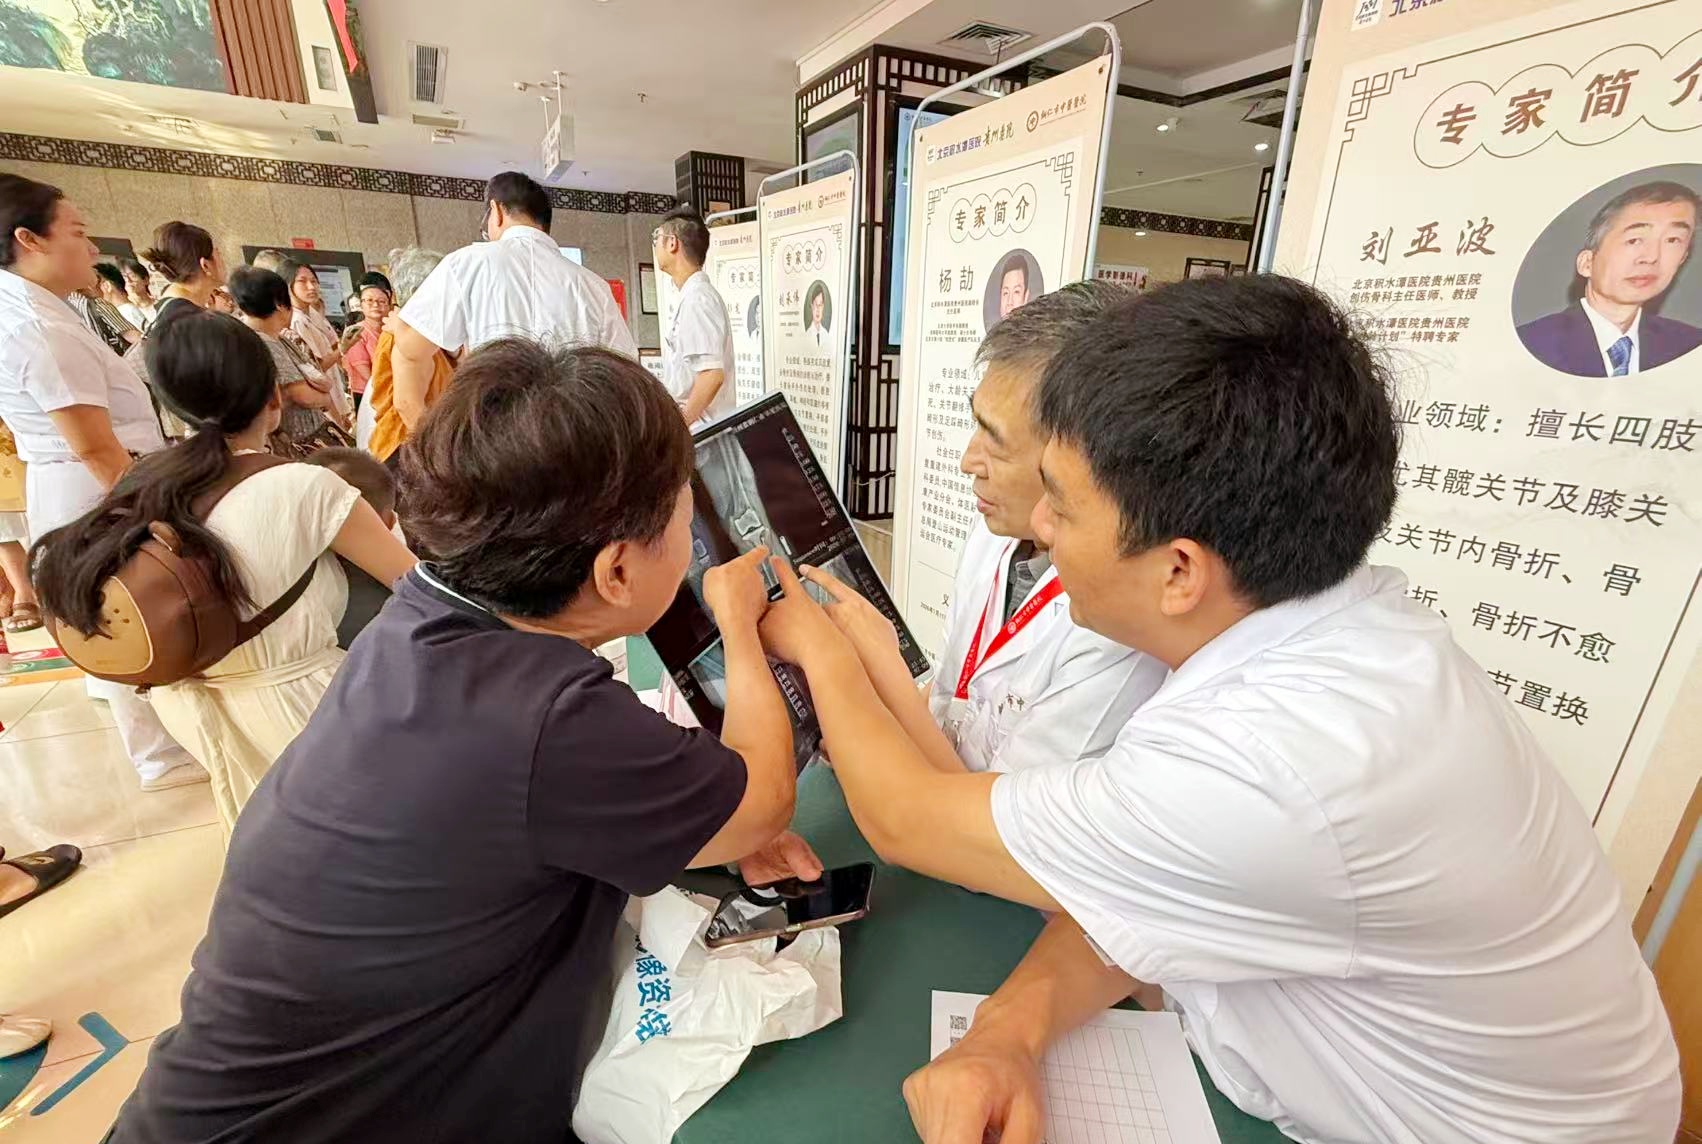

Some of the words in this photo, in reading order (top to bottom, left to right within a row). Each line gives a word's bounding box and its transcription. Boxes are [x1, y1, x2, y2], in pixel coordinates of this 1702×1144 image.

[955, 195, 1030, 231] 专家简介
[786, 247, 823, 266] 专家简介
[1360, 216, 1497, 266] 刘亚波
[1350, 288, 1479, 304] 创伤骨科主任医师、教授
[1352, 273, 1482, 290] 北京积水潭医院贵州医院
[1404, 585, 1617, 664] 折、骨折不愈
[1487, 670, 1589, 726] 节置换
